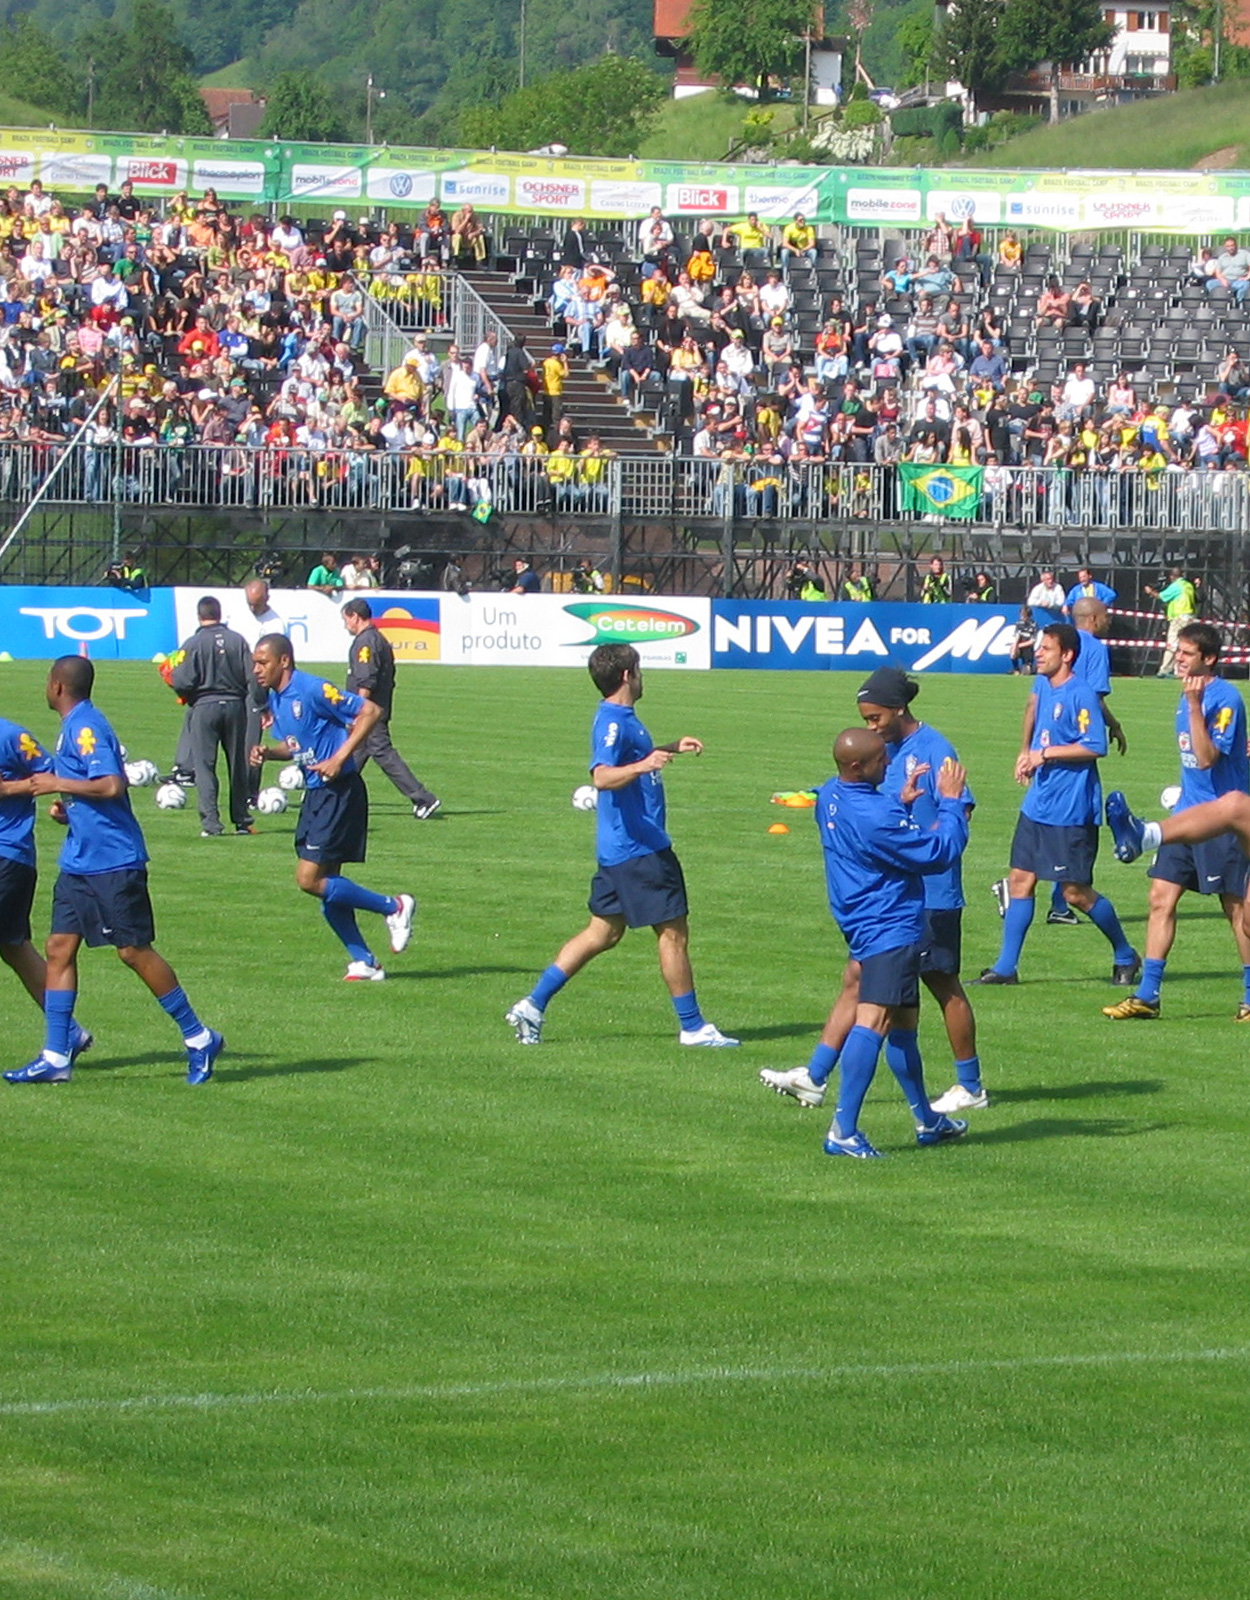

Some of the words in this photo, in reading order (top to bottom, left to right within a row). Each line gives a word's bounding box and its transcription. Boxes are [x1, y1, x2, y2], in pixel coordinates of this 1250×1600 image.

[128, 161, 168, 179] Blick
[459, 185, 506, 196] sunrise
[522, 181, 579, 193] OCHSNER
[531, 194, 569, 205] SPORT
[679, 189, 719, 206] Blick
[1026, 204, 1075, 216] sunrise
[19, 606, 148, 640] TOT
[483, 607, 517, 626] Um
[597, 617, 686, 634] Cetelem
[462, 631, 542, 652] produto
[715, 614, 889, 656] NIVEA
[890, 628, 931, 645] FOR
[912, 615, 1046, 671] Me
[829, 803, 838, 817] 9
